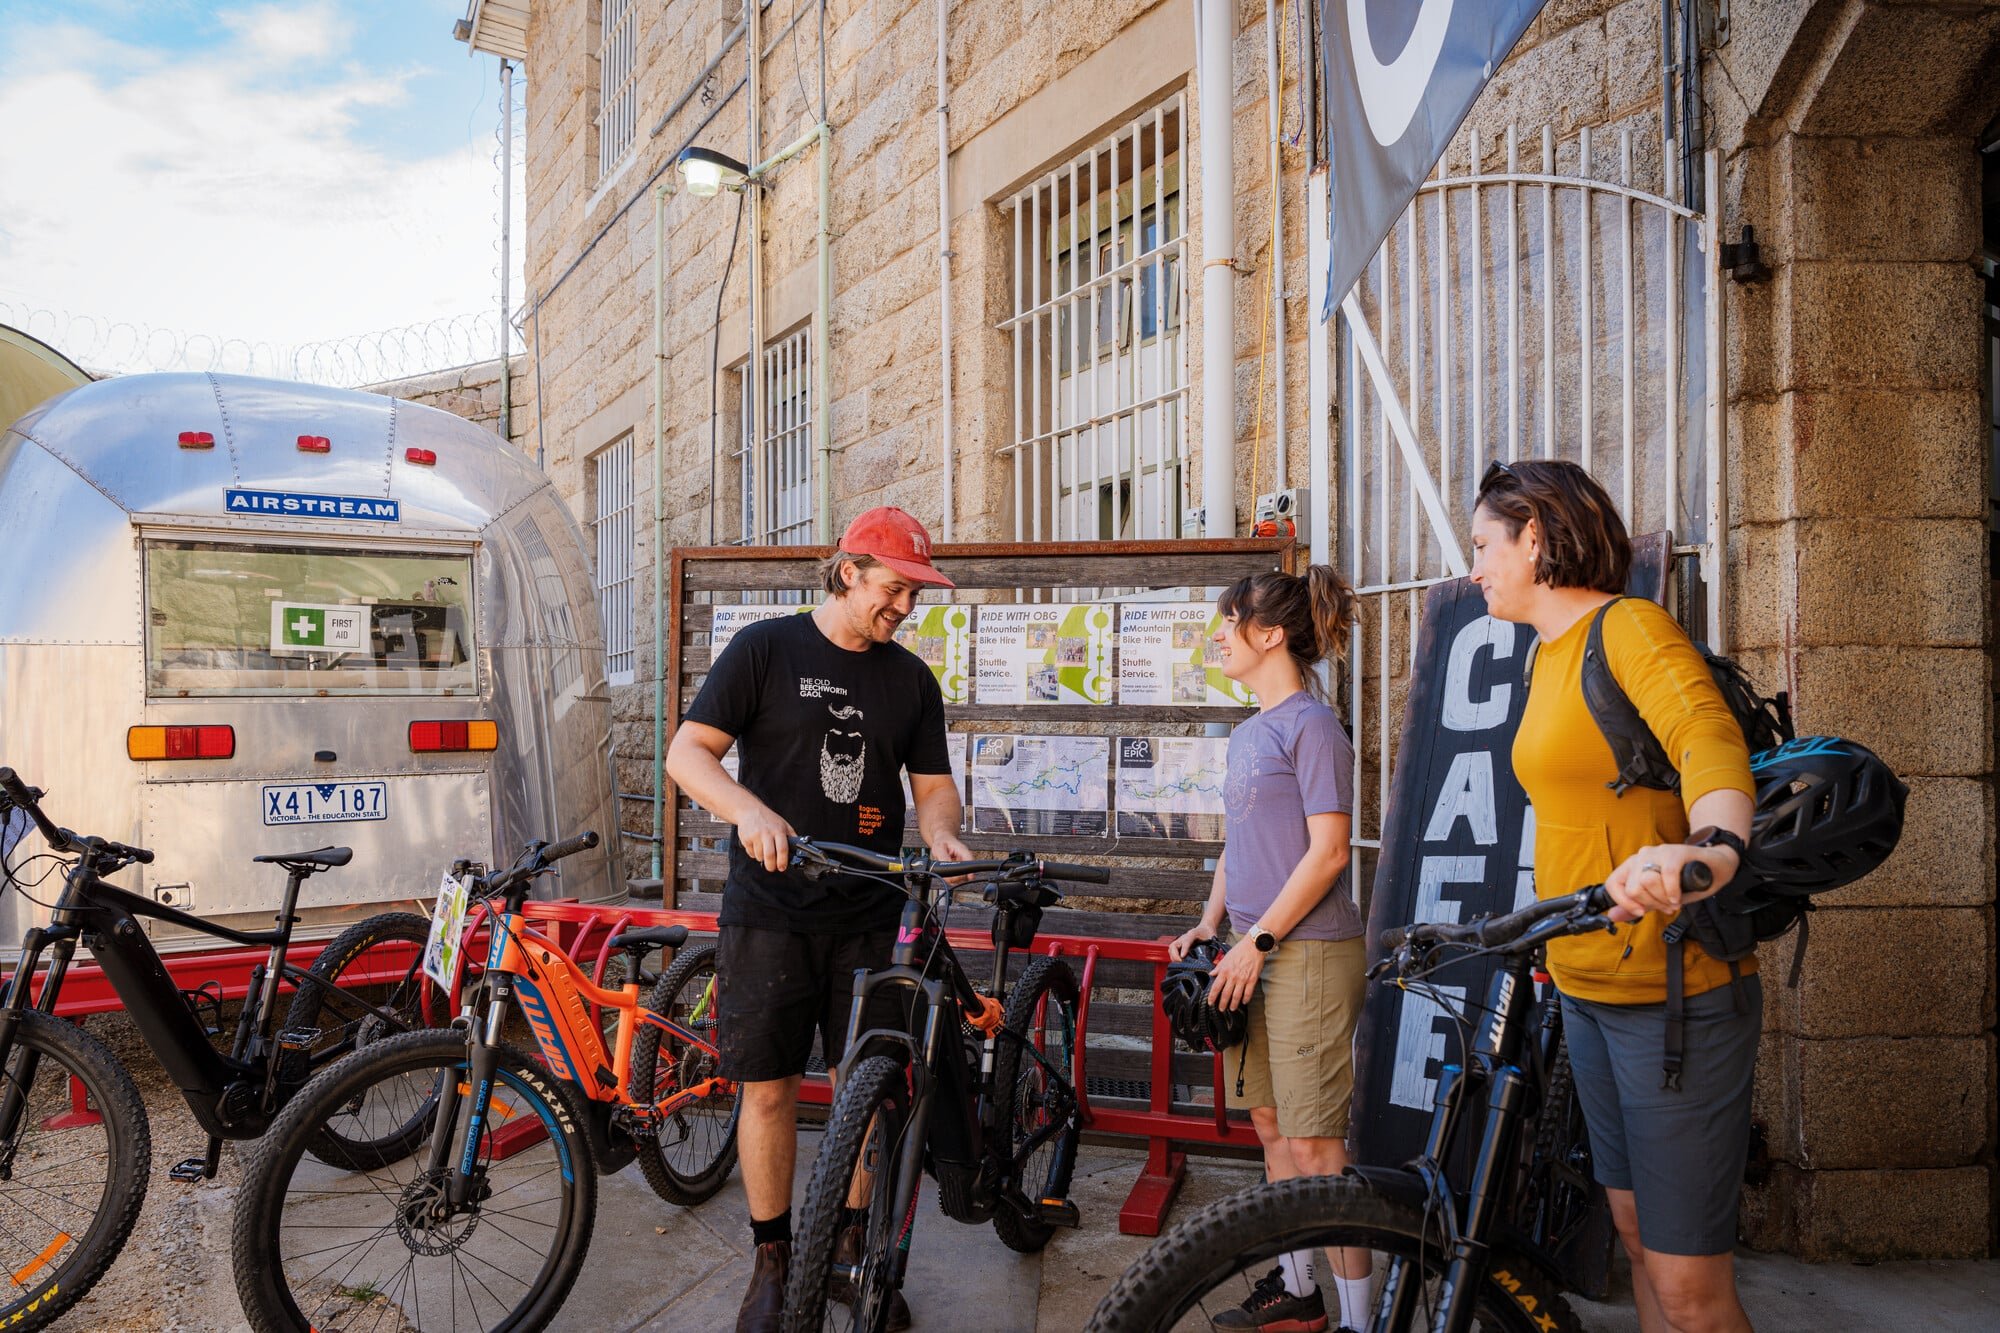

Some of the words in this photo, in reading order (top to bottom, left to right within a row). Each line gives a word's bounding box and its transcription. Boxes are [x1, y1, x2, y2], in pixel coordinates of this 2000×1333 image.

[231, 494, 395, 517] AIRSTREAM
[716, 612, 735, 620] RIDE
[739, 612, 760, 620] WITH
[981, 612, 1003, 621] RIDE
[1006, 612, 1030, 620] WITH
[1034, 612, 1058, 620] OBG
[1124, 611, 1148, 620] RIDE
[1151, 611, 1176, 620] WITH
[1180, 611, 1205, 620] OBG
[332, 619, 353, 628] FIRST
[980, 625, 1025, 633] eMountain
[1123, 624, 1171, 633] eMountain
[335, 631, 348, 640] AID
[979, 636, 997, 644] Bike
[1000, 636, 1016, 644] Hire
[1122, 636, 1140, 644] Bike
[1144, 636, 1161, 644] Hire
[979, 658, 1007, 666] Shuttle
[1122, 658, 1151, 667] Shuttle
[979, 669, 1012, 678] Service.
[1122, 669, 1157, 678] Service.
[800, 677, 813, 685] THE
[814, 678, 830, 686] OLD
[800, 684, 848, 696] BEECHWORTH
[800, 690, 822, 698] GAOL
[988, 738, 1004, 748] GO
[1131, 740, 1148, 750] GO
[980, 747, 1004, 755] EPIC
[1124, 749, 1148, 758] EPIC
[268, 791, 313, 815] X41
[339, 788, 381, 812] 187
[1389, 615, 1516, 1113] CAFE
[1489, 971, 1516, 1054] GIANT
[513, 986, 574, 1081] GIANT
[516, 1068, 576, 1135] MAXXIS
[465, 1125, 479, 1160] SUNTOUR
